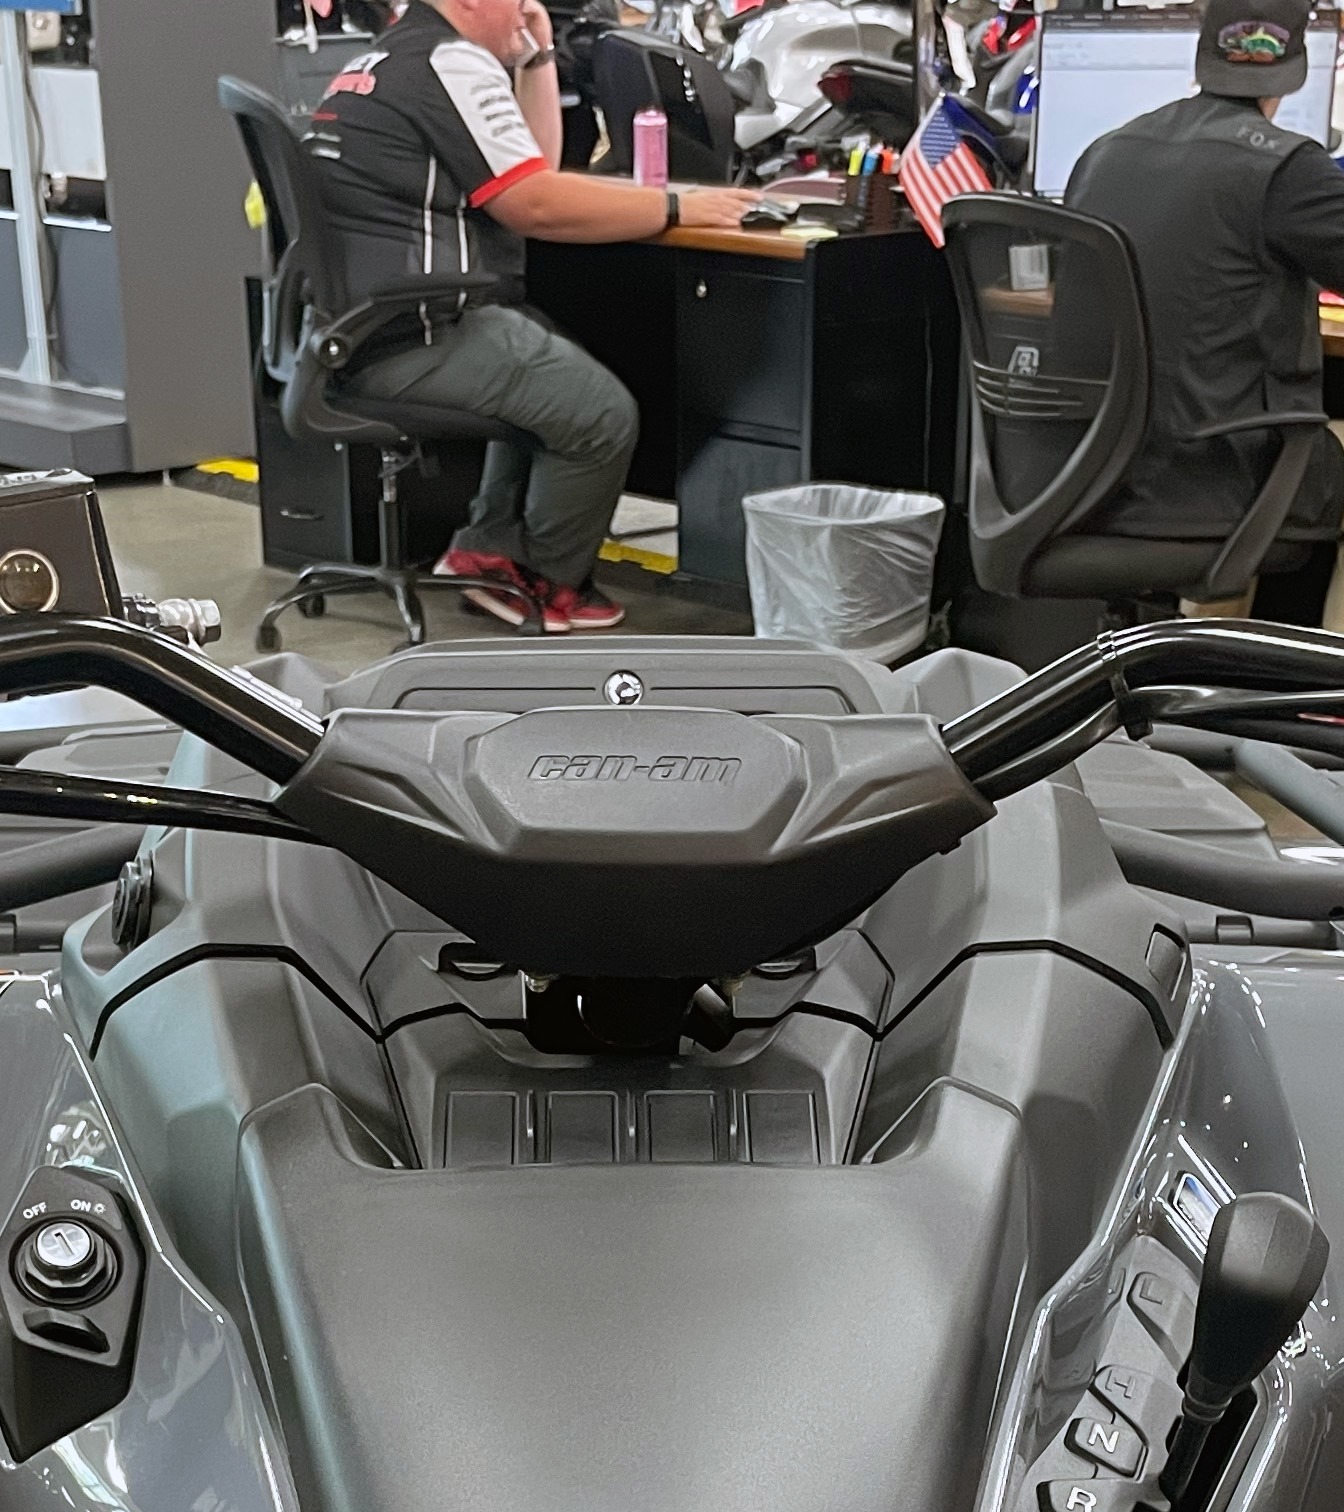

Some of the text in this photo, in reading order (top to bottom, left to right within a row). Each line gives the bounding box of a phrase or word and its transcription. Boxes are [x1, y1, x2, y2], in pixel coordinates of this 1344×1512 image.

[1236, 127, 1280, 148] FOX
[527, 754, 742, 785] can-am
[23, 1200, 91, 1219] OFF ON
[1105, 1371, 1136, 1400] H
[1088, 1423, 1120, 1454] N
